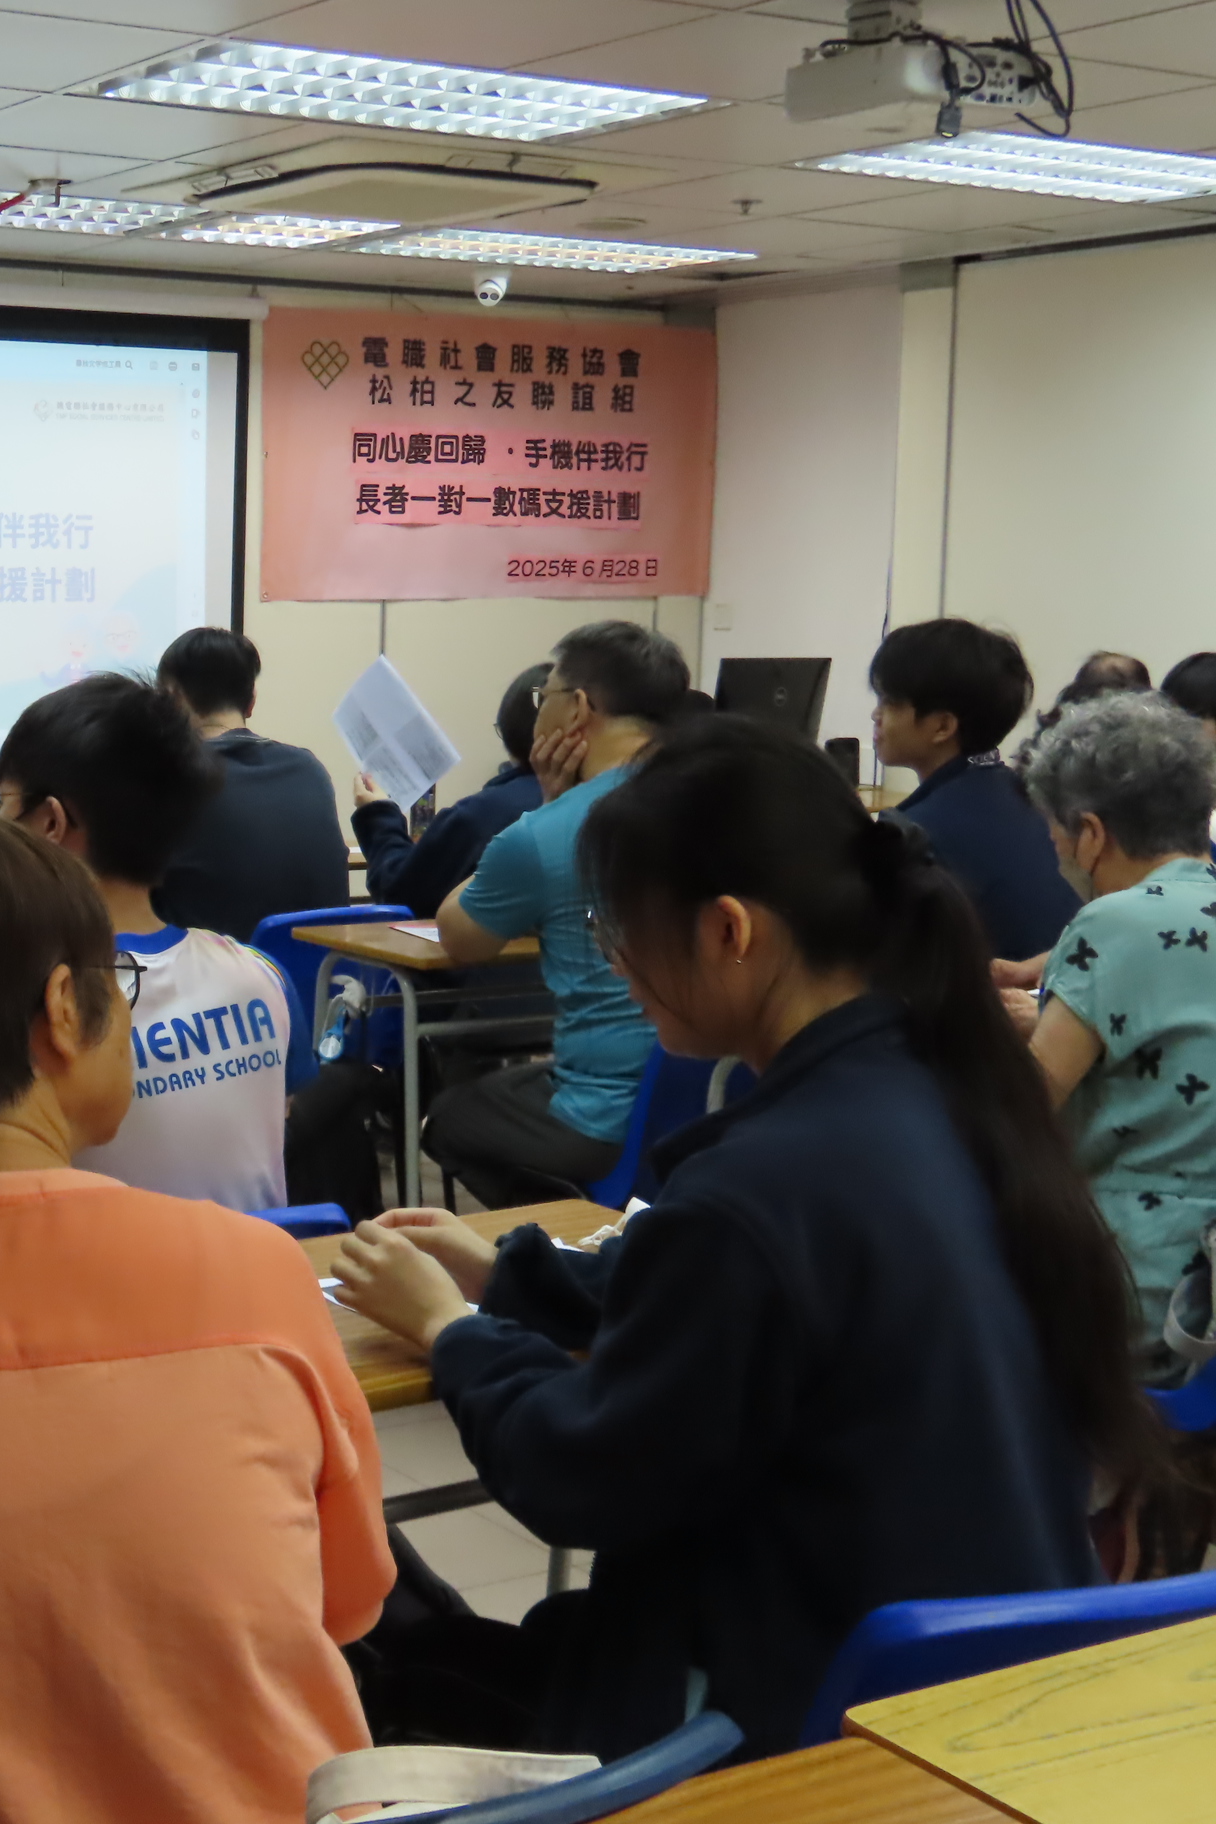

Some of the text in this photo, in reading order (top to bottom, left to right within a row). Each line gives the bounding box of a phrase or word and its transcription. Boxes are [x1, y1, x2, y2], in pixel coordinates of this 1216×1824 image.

[362, 336, 641, 378] 電職社會服務協會
[368, 373, 635, 413] 松柏之友聯誼組
[356, 484, 640, 521] 長者一對一數碼支援計劃
[133, 1049, 282, 1099] NDARY SCHOOL
